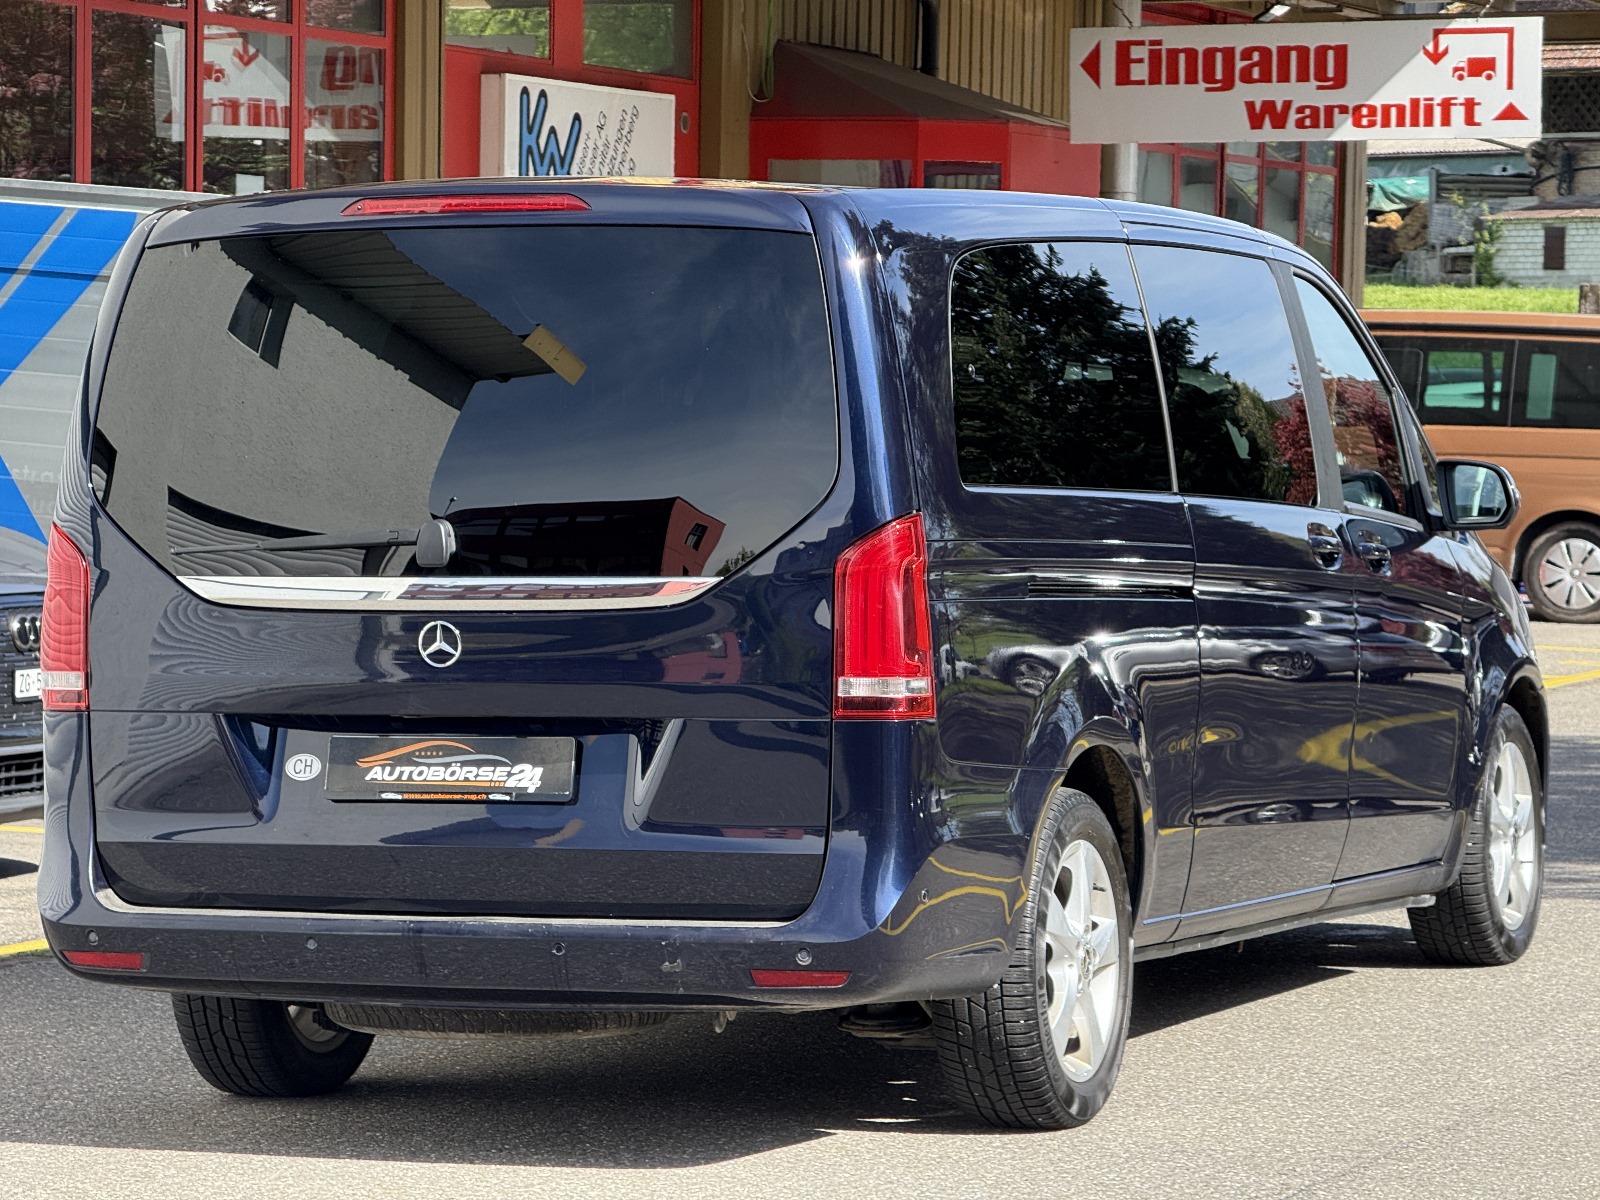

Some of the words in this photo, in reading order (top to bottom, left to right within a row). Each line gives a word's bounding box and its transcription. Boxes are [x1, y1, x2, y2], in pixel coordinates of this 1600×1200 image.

[1115, 38, 1348, 92] Eingang
[519, 86, 582, 176] KW
[607, 108, 628, 176] izungen
[614, 104, 639, 176] nenberg
[1244, 97, 1482, 130] Warenlift
[293, 758, 314, 777] CH
